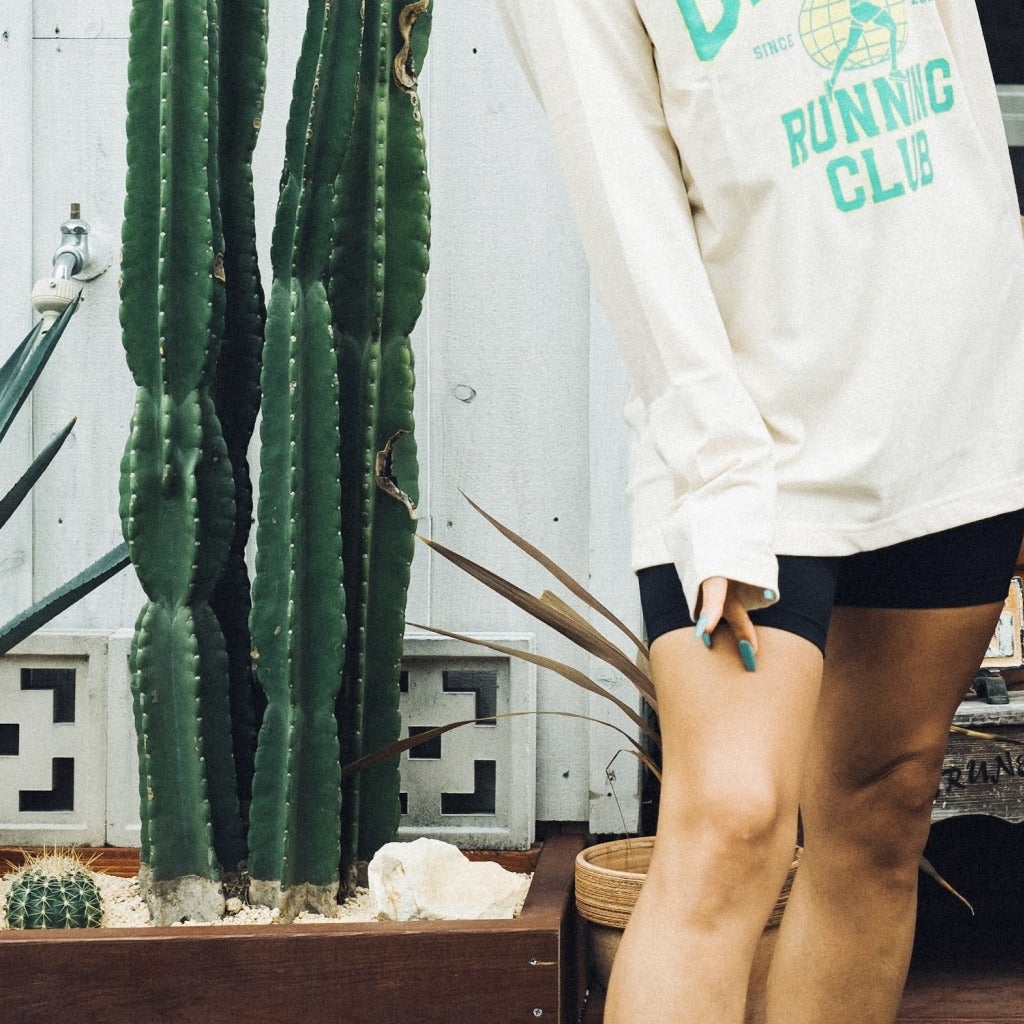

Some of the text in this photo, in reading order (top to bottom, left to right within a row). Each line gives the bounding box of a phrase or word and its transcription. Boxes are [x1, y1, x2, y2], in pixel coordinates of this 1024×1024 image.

[753, 34, 795, 60] SINCE
[780, 57, 955, 169] RUNNING
[825, 129, 934, 213] CLUB
